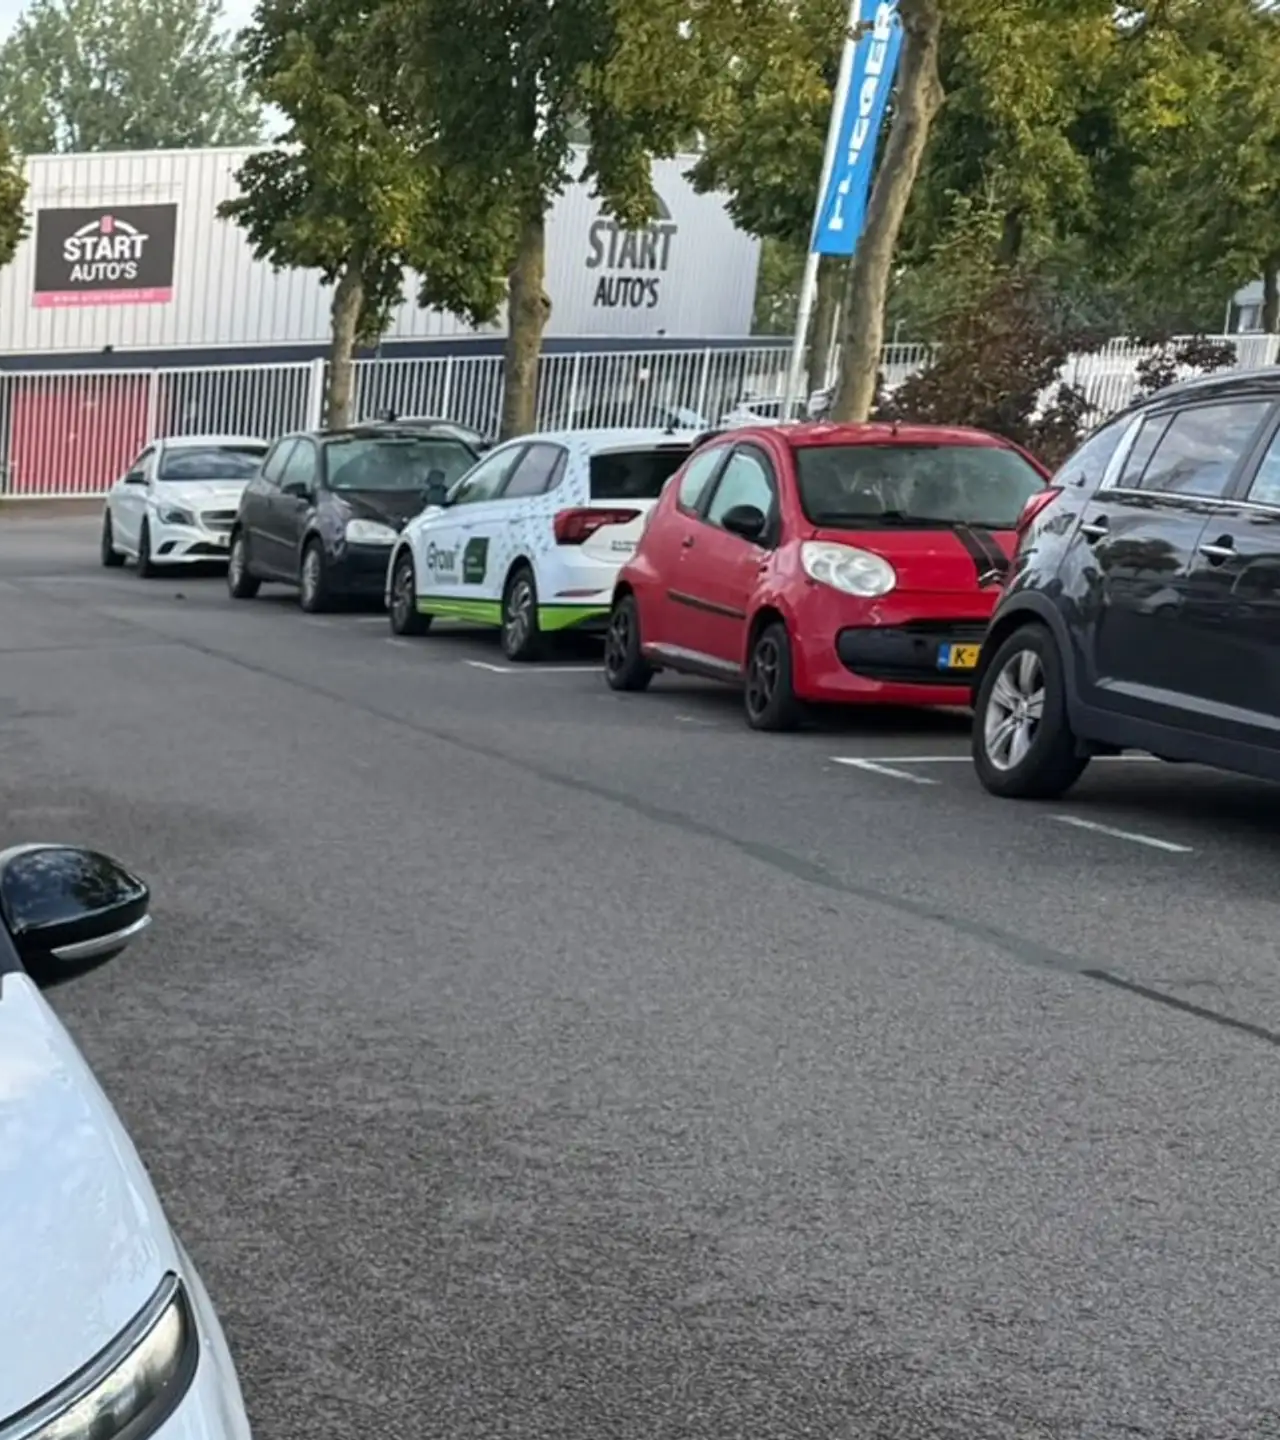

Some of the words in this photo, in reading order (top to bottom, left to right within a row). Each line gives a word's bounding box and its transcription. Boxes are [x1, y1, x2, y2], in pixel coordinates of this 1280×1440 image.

[63, 234, 149, 262] START
[585, 219, 678, 271] START
[69, 261, 138, 282] AUTO'S
[593, 276, 660, 309] AUTO'S
